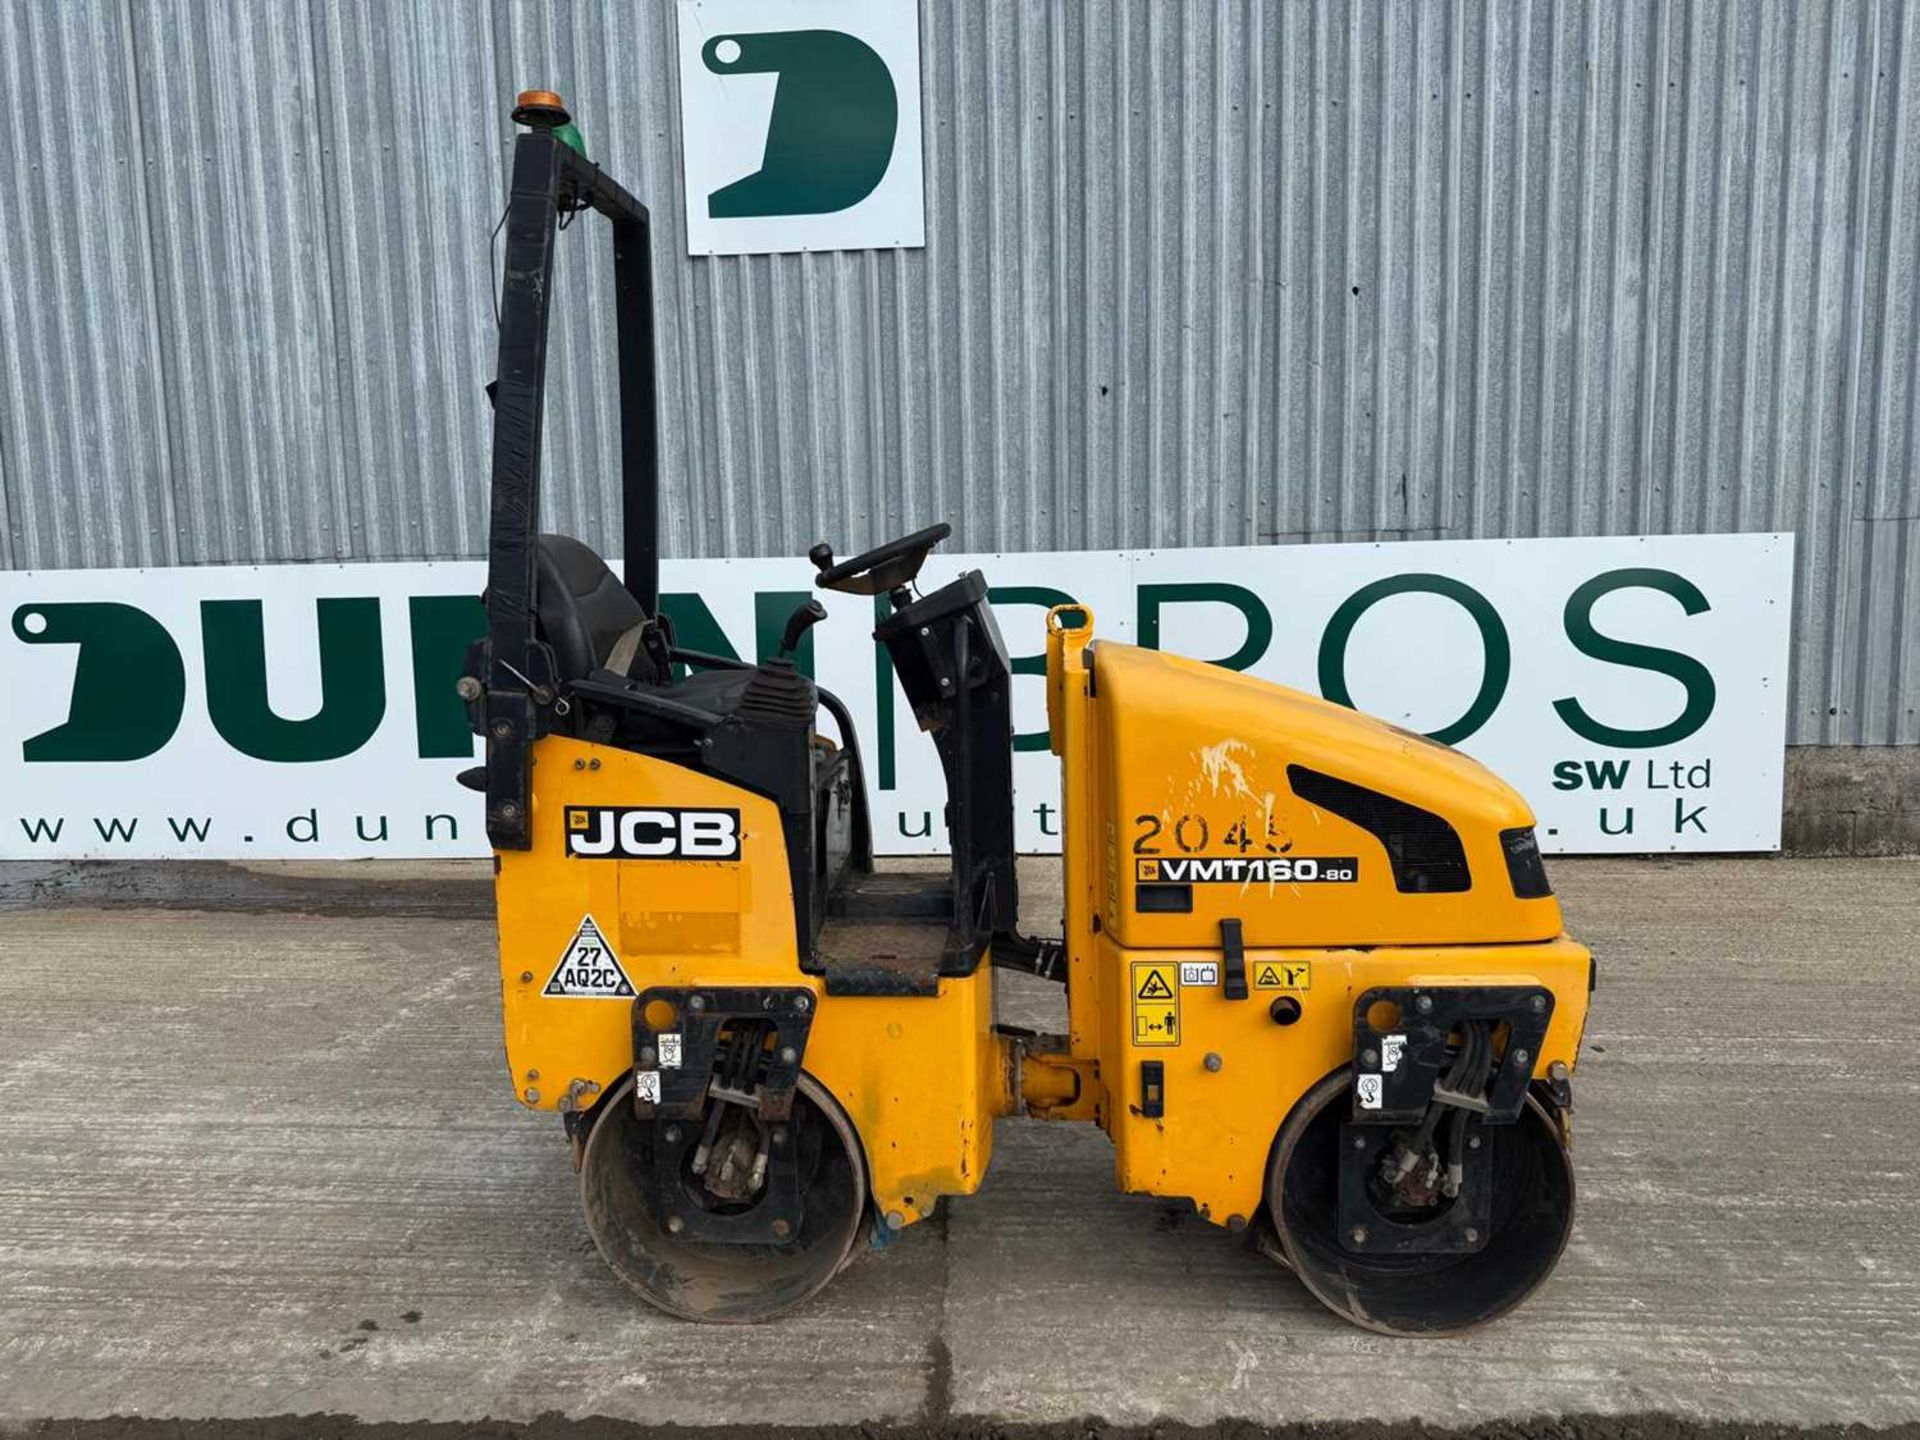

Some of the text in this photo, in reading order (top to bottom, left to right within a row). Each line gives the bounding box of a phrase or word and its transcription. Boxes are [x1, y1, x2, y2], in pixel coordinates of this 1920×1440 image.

[1647, 758, 1711, 789] Ltd
[570, 810, 737, 856] JCB
[577, 946, 602, 967] 27
[564, 968, 617, 988] AQ2C
